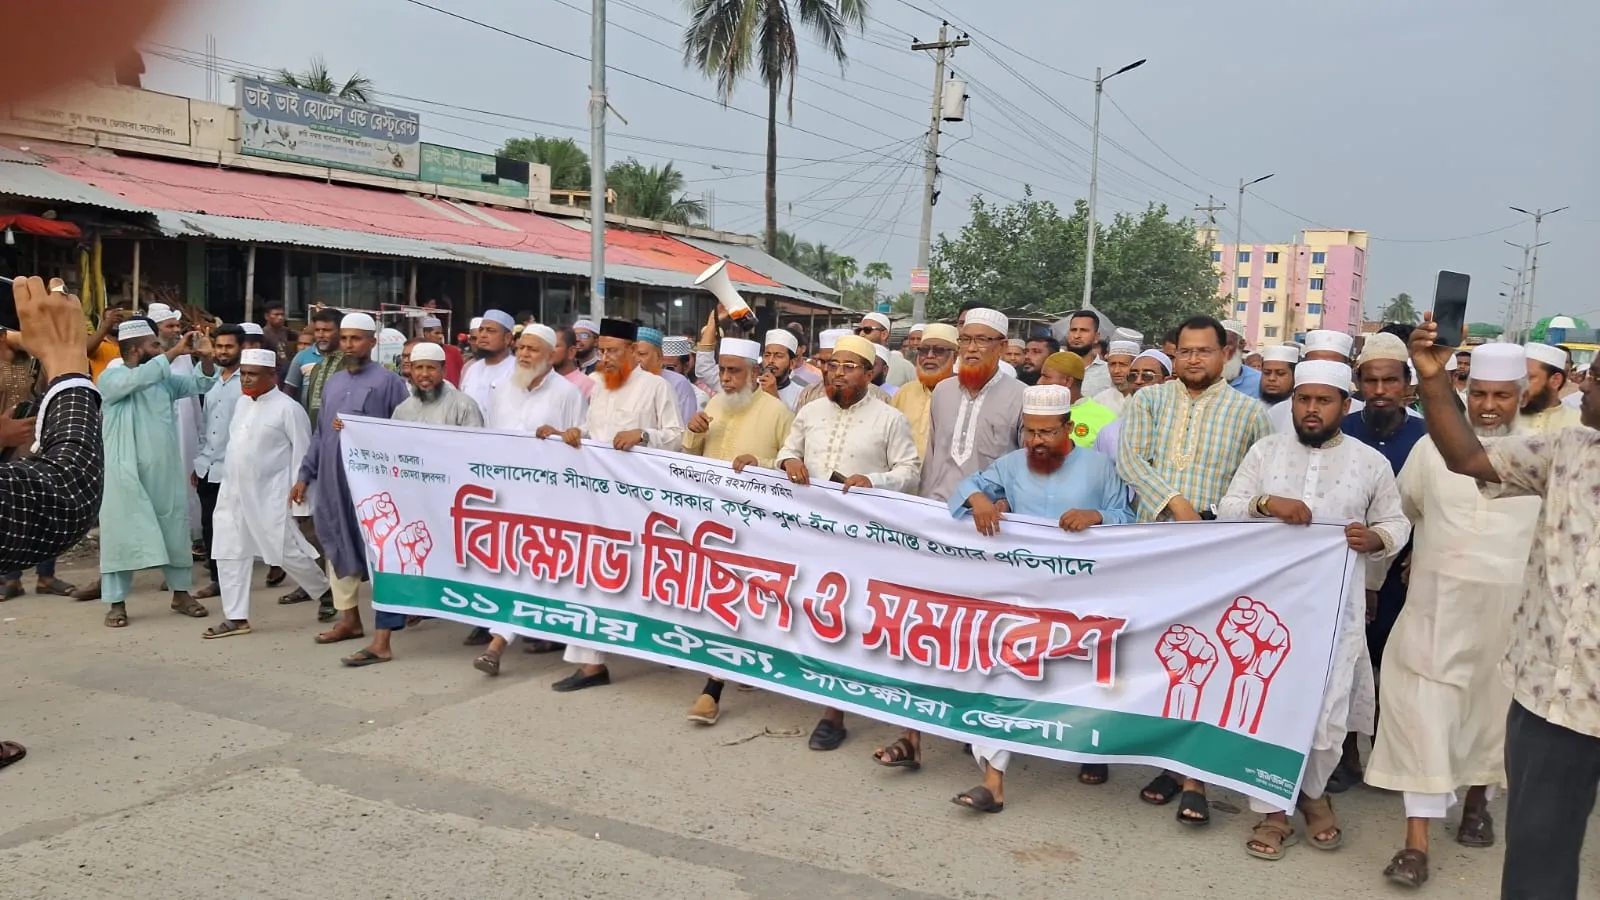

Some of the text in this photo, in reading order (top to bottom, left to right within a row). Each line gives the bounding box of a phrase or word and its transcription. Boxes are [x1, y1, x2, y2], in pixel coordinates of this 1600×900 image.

[245, 85, 271, 111] ভাই
[274, 92, 299, 117] ভাই
[303, 98, 344, 124] হোটেল
[347, 108, 369, 127] এন্ড
[468, 462, 558, 486] বাংলাদেশের
[562, 467, 609, 493] সীমান্তে
[615, 480, 656, 501] ভারত
[661, 489, 715, 513] সরকার
[720, 499, 767, 527] কর্তৃক
[844, 524, 859, 538] ও
[865, 520, 920, 550] সীমান্ত
[725, 476, 767, 494] রহমানির
[769, 483, 794, 498] রহিম
[450, 483, 1129, 687] বিক্ষোভ মিছিল ও সমাবেশ
[440, 586, 500, 614] ১১
[513, 599, 638, 643] দলীয়
[801, 667, 953, 720] সাতক্ষীরা
[962, 709, 1072, 742] জেলা
